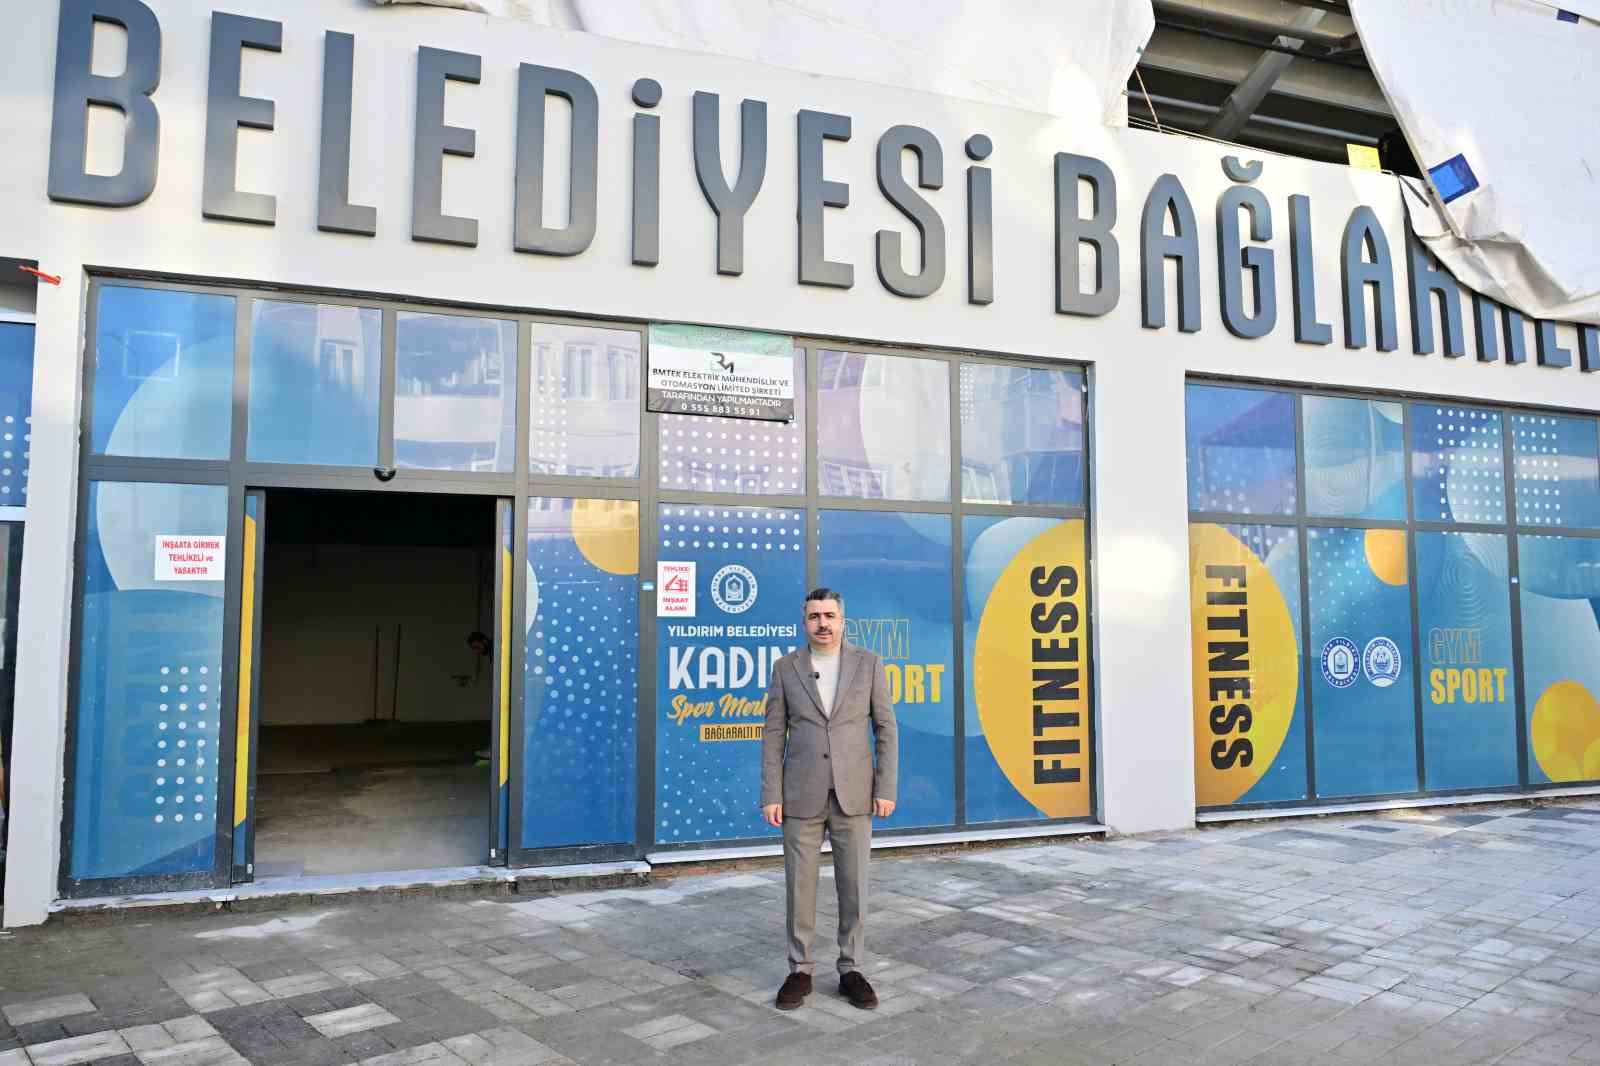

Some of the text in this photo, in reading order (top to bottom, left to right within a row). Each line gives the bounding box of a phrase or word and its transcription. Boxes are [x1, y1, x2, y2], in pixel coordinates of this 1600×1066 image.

[661, 379, 716, 391] OTOMASYON
[667, 623, 797, 638] YILDIRIM BELEDİYESİ
[884, 663, 945, 705] ORT
[1030, 565, 1081, 785] FITNESS
[1205, 564, 1254, 771] FITNESS
[1429, 668, 1507, 705] SPORT
[666, 694, 715, 726] Spor
